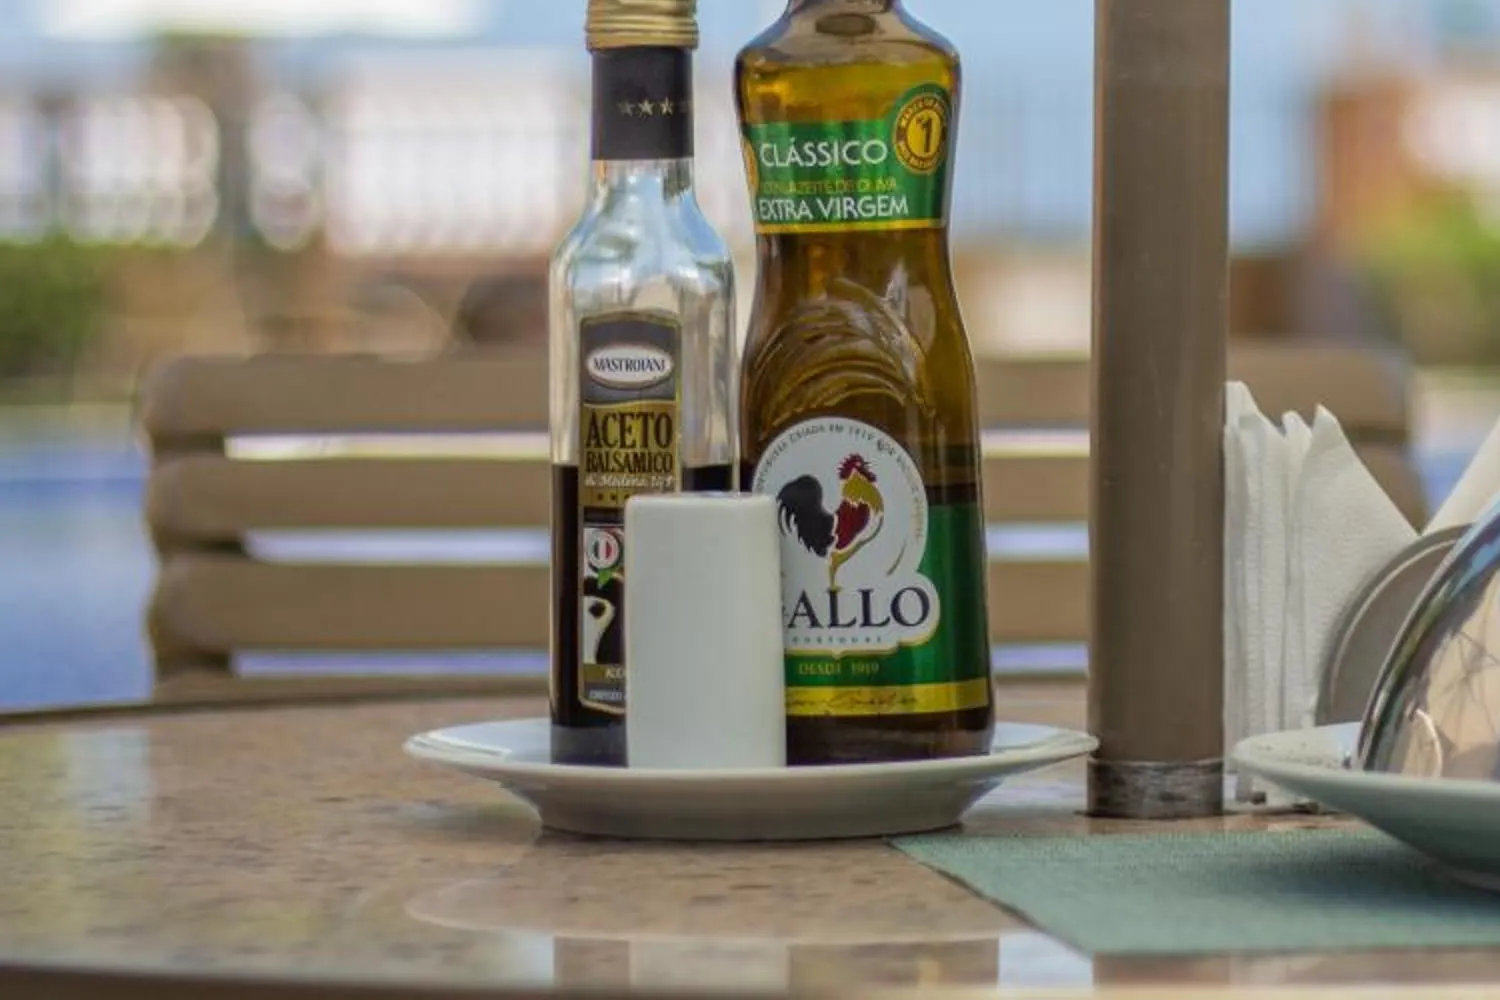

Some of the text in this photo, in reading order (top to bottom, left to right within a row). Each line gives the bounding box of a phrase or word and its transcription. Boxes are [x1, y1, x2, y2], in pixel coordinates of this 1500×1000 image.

[759, 136, 889, 168] CLÁSSICO
[759, 194, 909, 220] EXTRA VIRGEM
[585, 410, 674, 449] ACETO
[585, 450, 674, 474] BALSAMICO
[783, 586, 931, 629] ALLO
